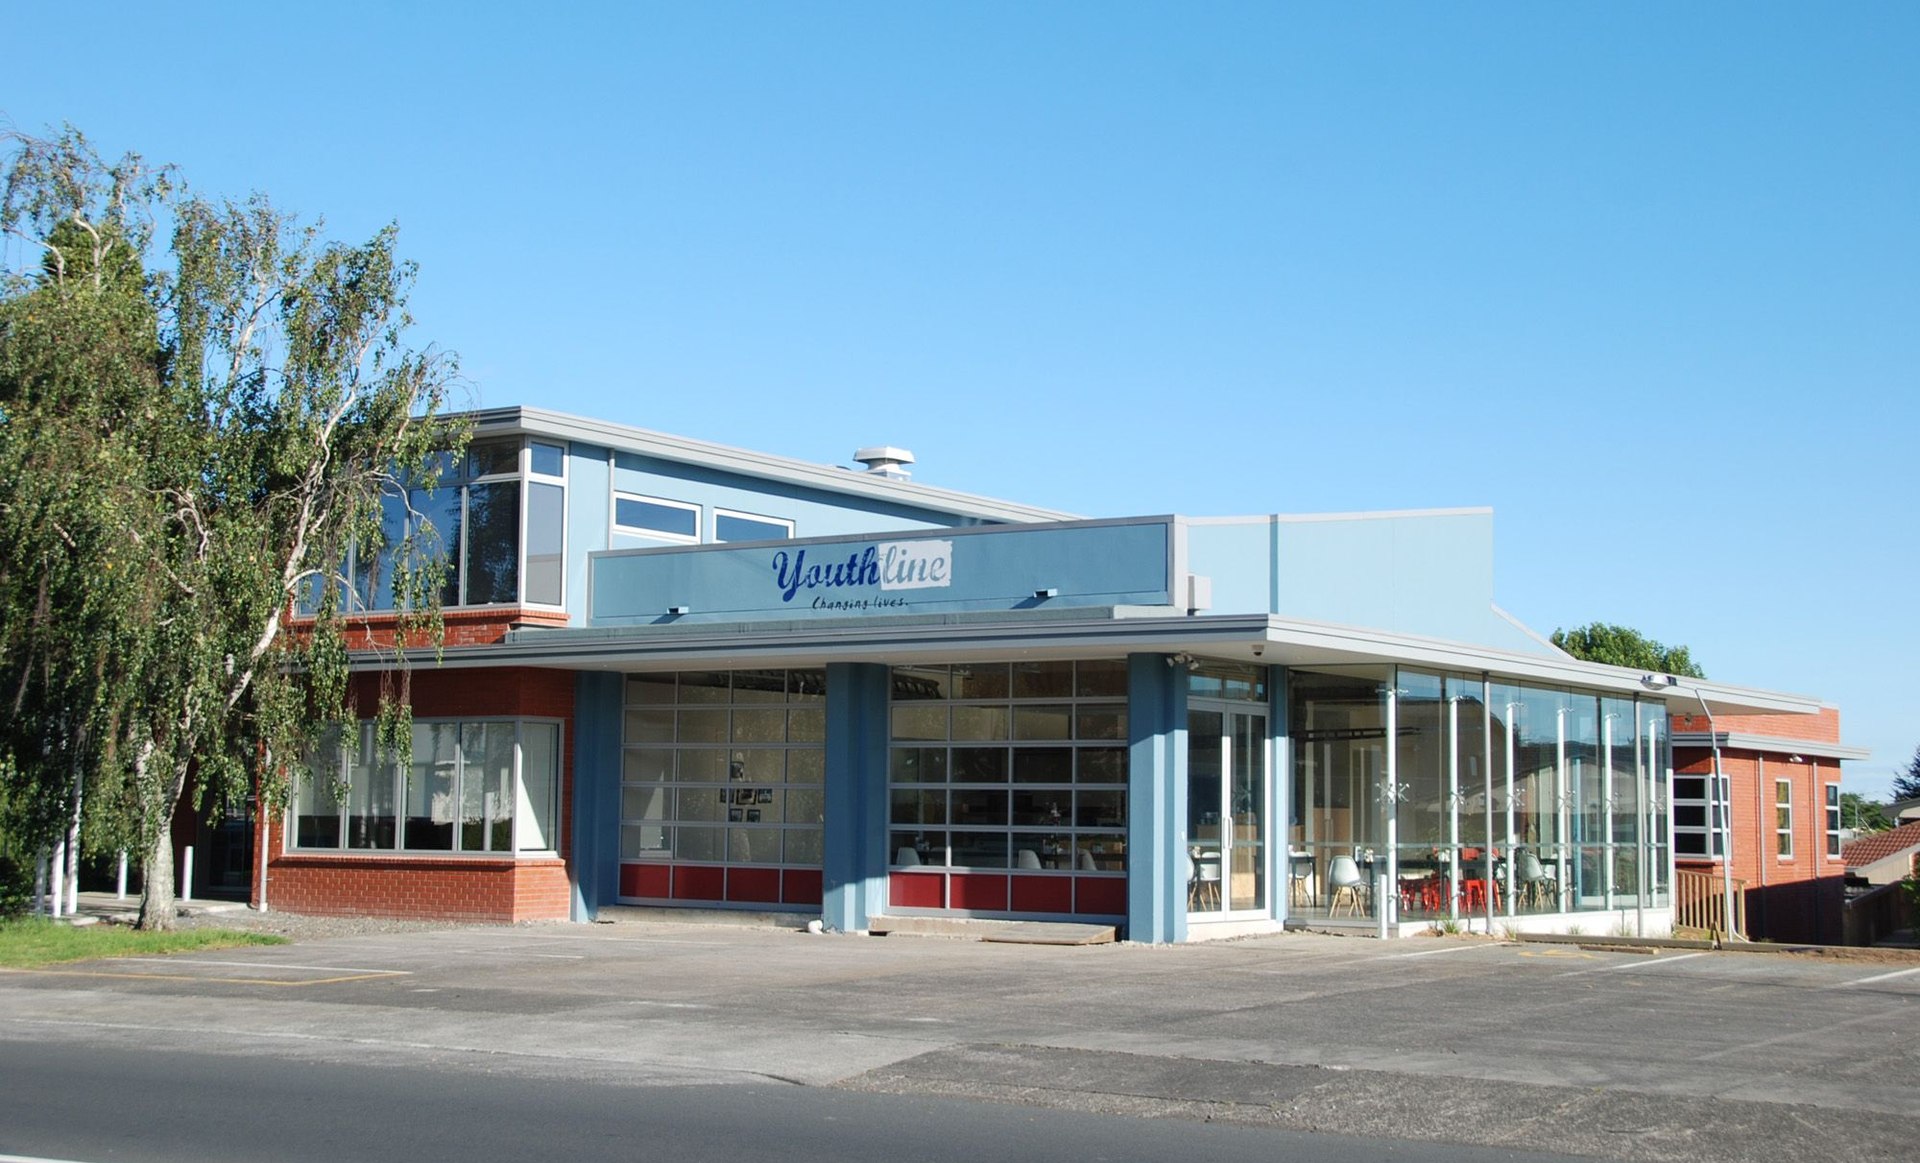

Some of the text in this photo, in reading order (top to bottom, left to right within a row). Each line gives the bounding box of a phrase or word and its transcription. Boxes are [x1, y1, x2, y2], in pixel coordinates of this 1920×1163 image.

[772, 545, 948, 602] Youthline
[812, 594, 909, 611] Changing lives.
